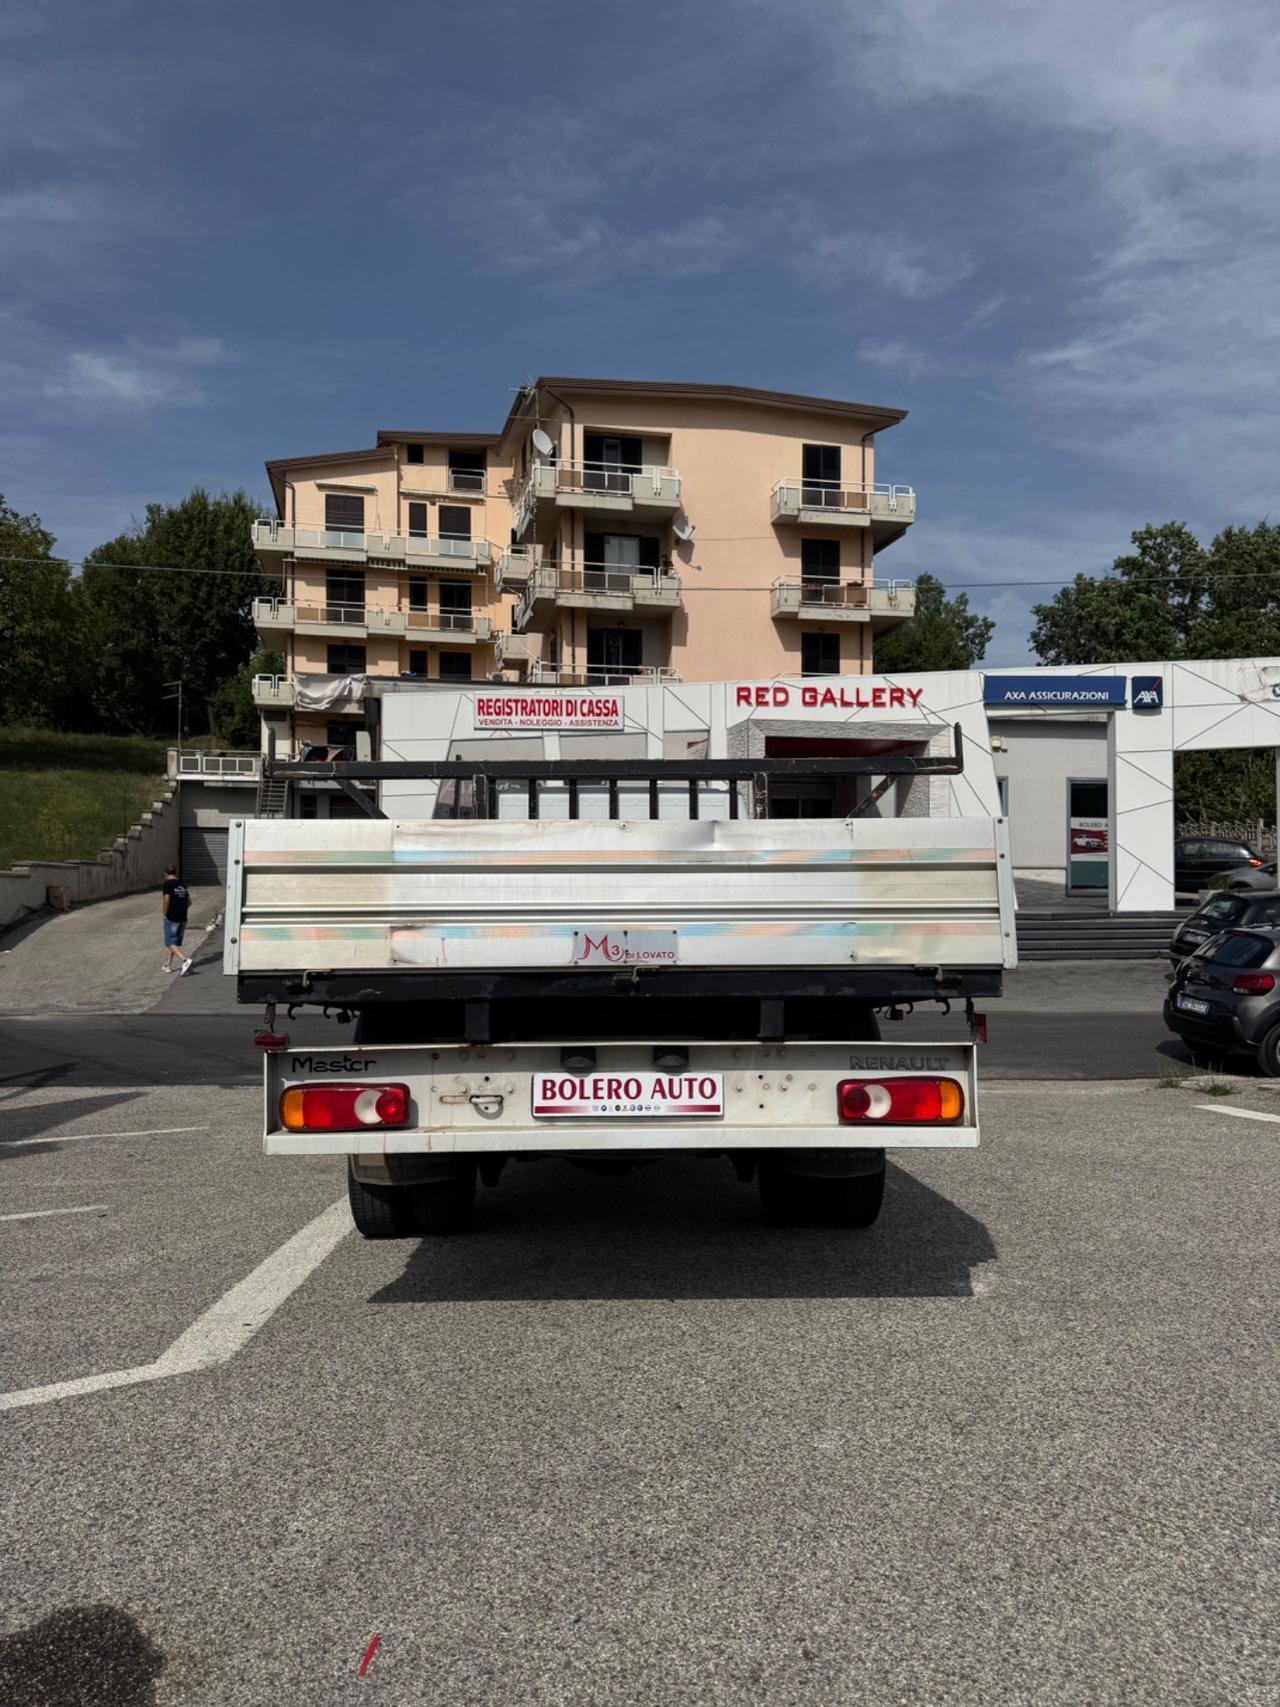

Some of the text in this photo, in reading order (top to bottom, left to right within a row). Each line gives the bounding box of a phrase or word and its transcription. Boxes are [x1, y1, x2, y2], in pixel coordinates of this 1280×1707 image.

[736, 687, 923, 708] RED GALLERY
[1005, 691, 1109, 700] AXA ASSICURAZIONI
[1134, 690, 1159, 703] AXA
[477, 698, 619, 717] REGISTRATORI DI CASSA
[479, 718, 513, 726] VENDITA
[519, 719, 562, 727] NOLEGGIO
[569, 719, 619, 727] ASSISTENZA
[637, 951, 675, 959] LOVATO
[291, 1054, 377, 1073] Master
[850, 1055, 950, 1071] RENAULT
[541, 1077, 717, 1101] BOLERO AUTO
